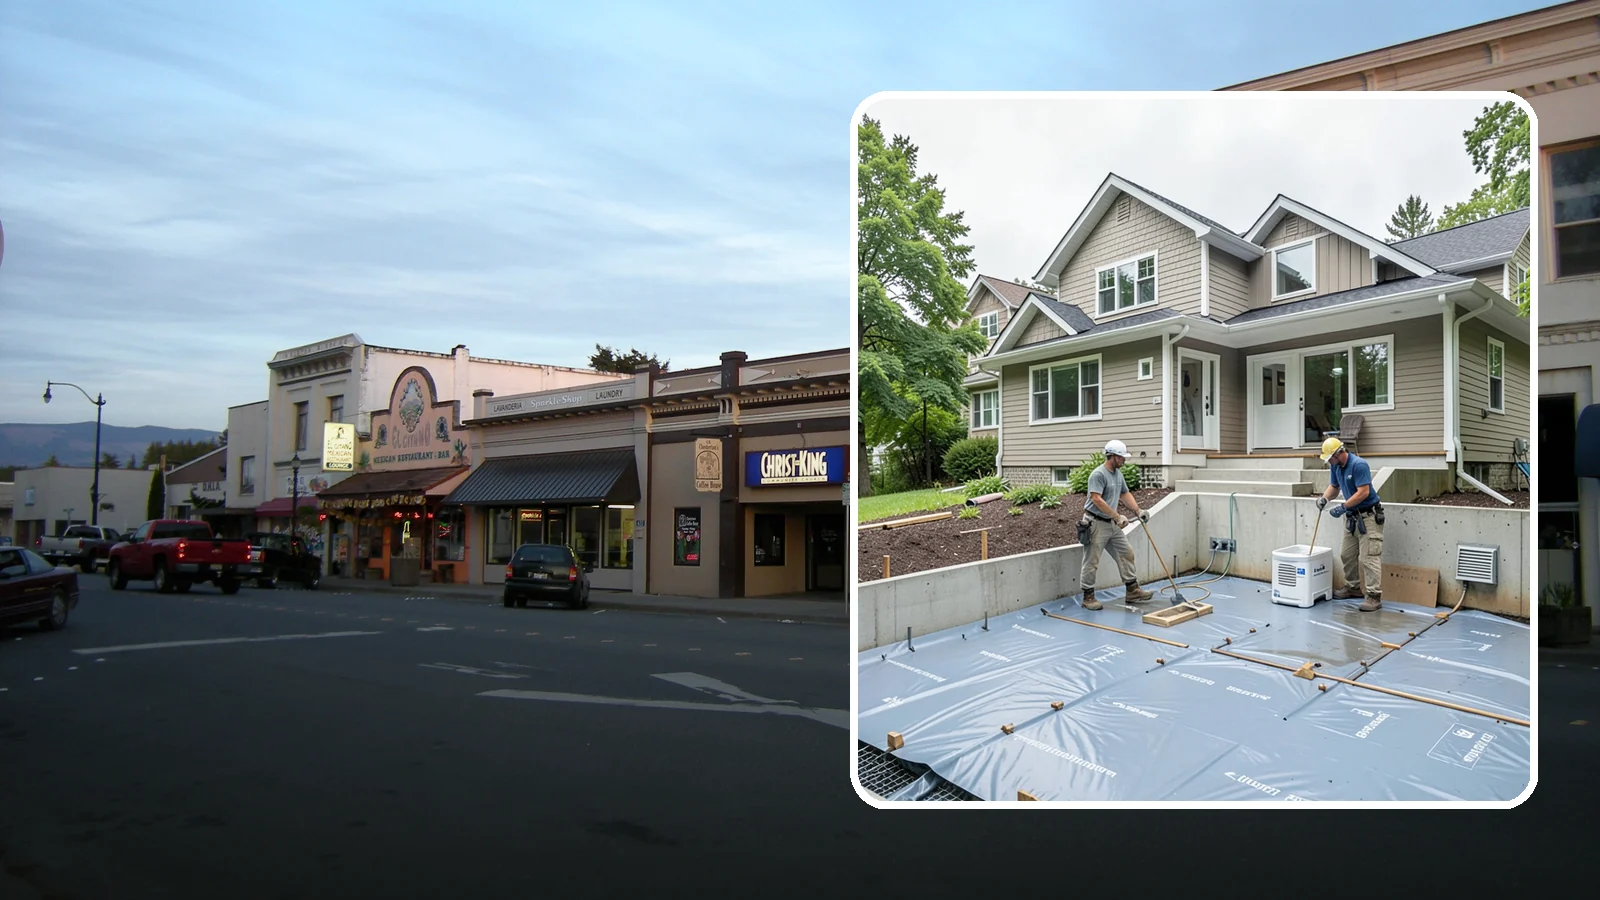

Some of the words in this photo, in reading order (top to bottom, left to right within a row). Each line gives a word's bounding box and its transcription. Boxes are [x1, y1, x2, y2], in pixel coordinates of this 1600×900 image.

[595, 389, 623, 400] LAUNDRY
[493, 402, 523, 413] LAVANDERIA
[531, 397, 561, 409] Sparkle
[562, 394, 582, 406] Shop
[373, 455, 396, 464] MEXICAN
[397, 452, 433, 462] RESTAURANT
[438, 450, 450, 459] BAR
[761, 452, 797, 478] CHRIST
[799, 450, 827, 476] KING
[697, 481, 709, 489] Coffee
